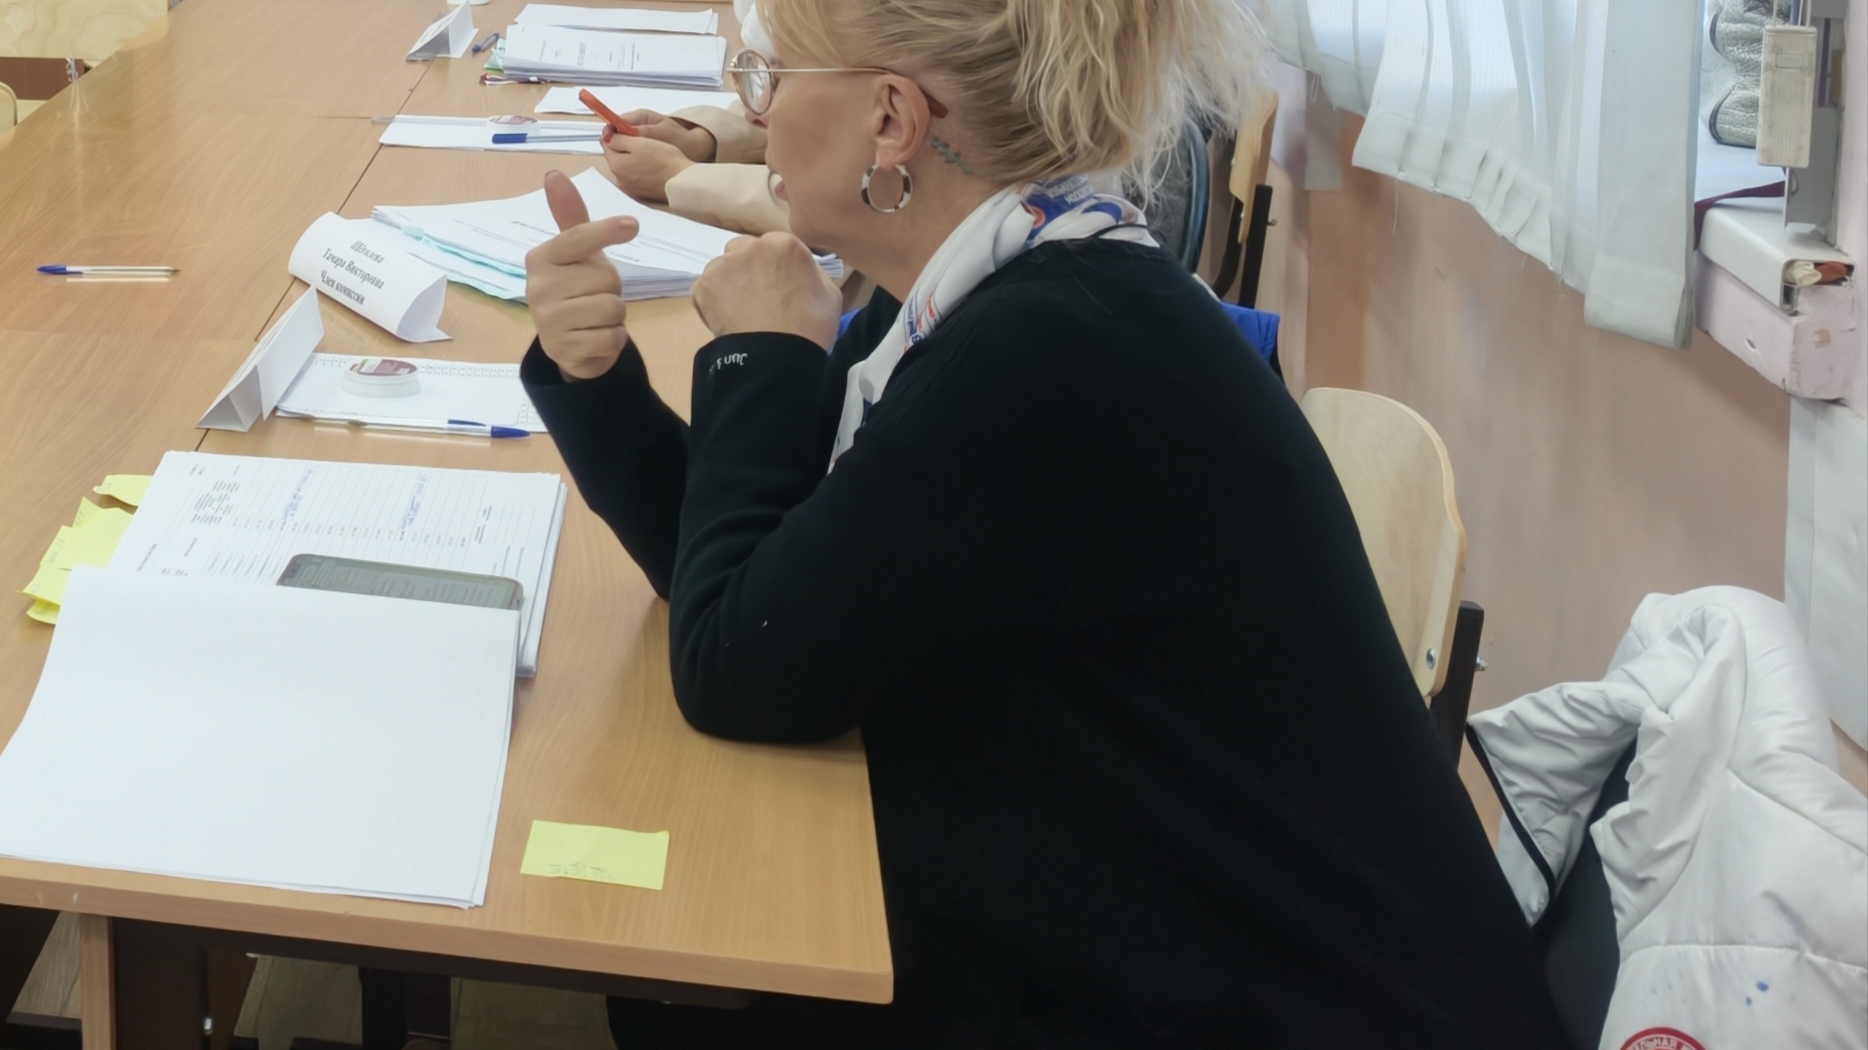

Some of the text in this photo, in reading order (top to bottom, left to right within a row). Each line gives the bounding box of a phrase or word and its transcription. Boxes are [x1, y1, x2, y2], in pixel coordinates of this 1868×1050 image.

[321, 269, 366, 306] Член комиссии
[322, 247, 385, 290] Тамара Викторовна
